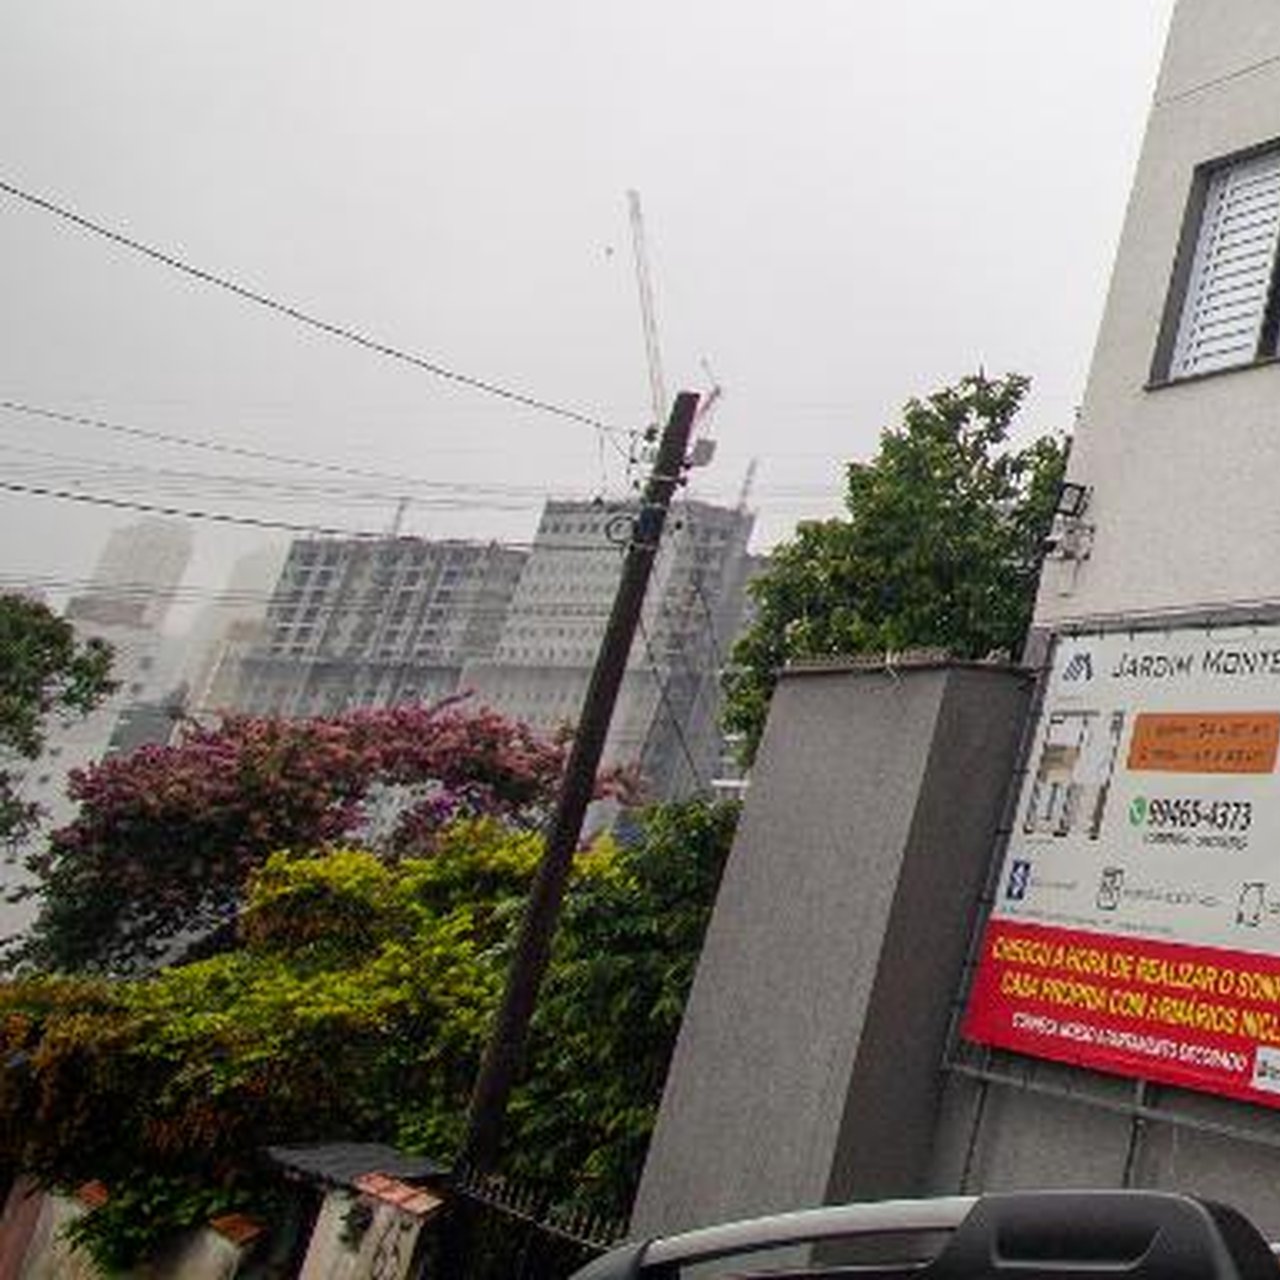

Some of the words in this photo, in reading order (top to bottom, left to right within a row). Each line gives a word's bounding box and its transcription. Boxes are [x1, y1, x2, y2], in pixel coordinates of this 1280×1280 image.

[1112, 651, 1195, 678] JARDIM
[1147, 797, 1252, 831] 99465-4373
[1052, 945, 1066, 967] A
[1067, 946, 1108, 978] HORA
[1111, 951, 1135, 981] DE
[1137, 955, 1219, 995] REALIZAR
[1219, 968, 1234, 995] O
